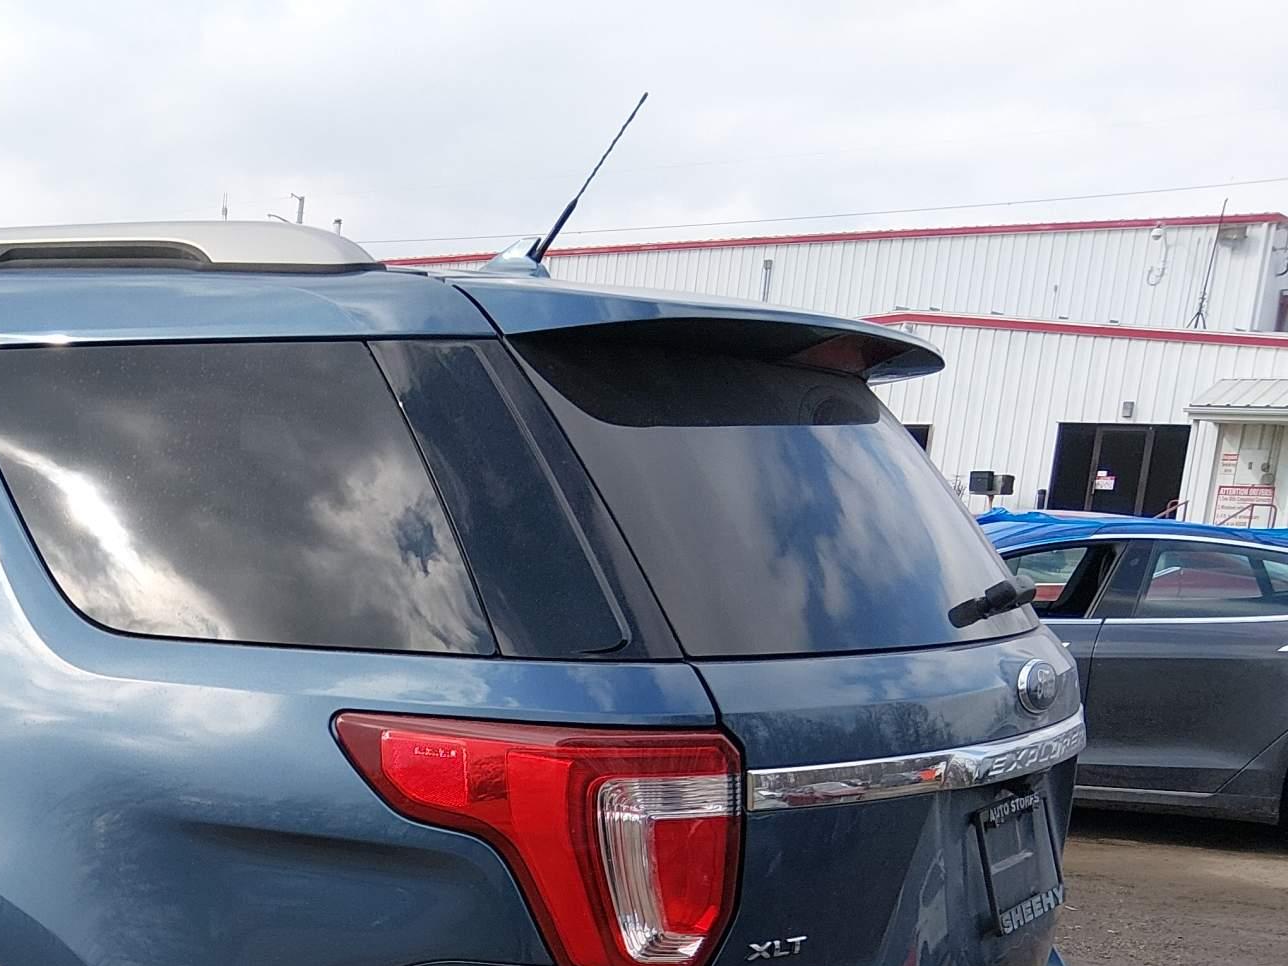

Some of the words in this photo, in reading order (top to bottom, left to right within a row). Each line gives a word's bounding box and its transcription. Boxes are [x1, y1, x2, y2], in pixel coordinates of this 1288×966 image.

[988, 806, 1010, 823] AUTO
[1011, 792, 1040, 813] STORES
[1001, 886, 1064, 935] SHEEHY
[746, 935, 808, 961] XLT
